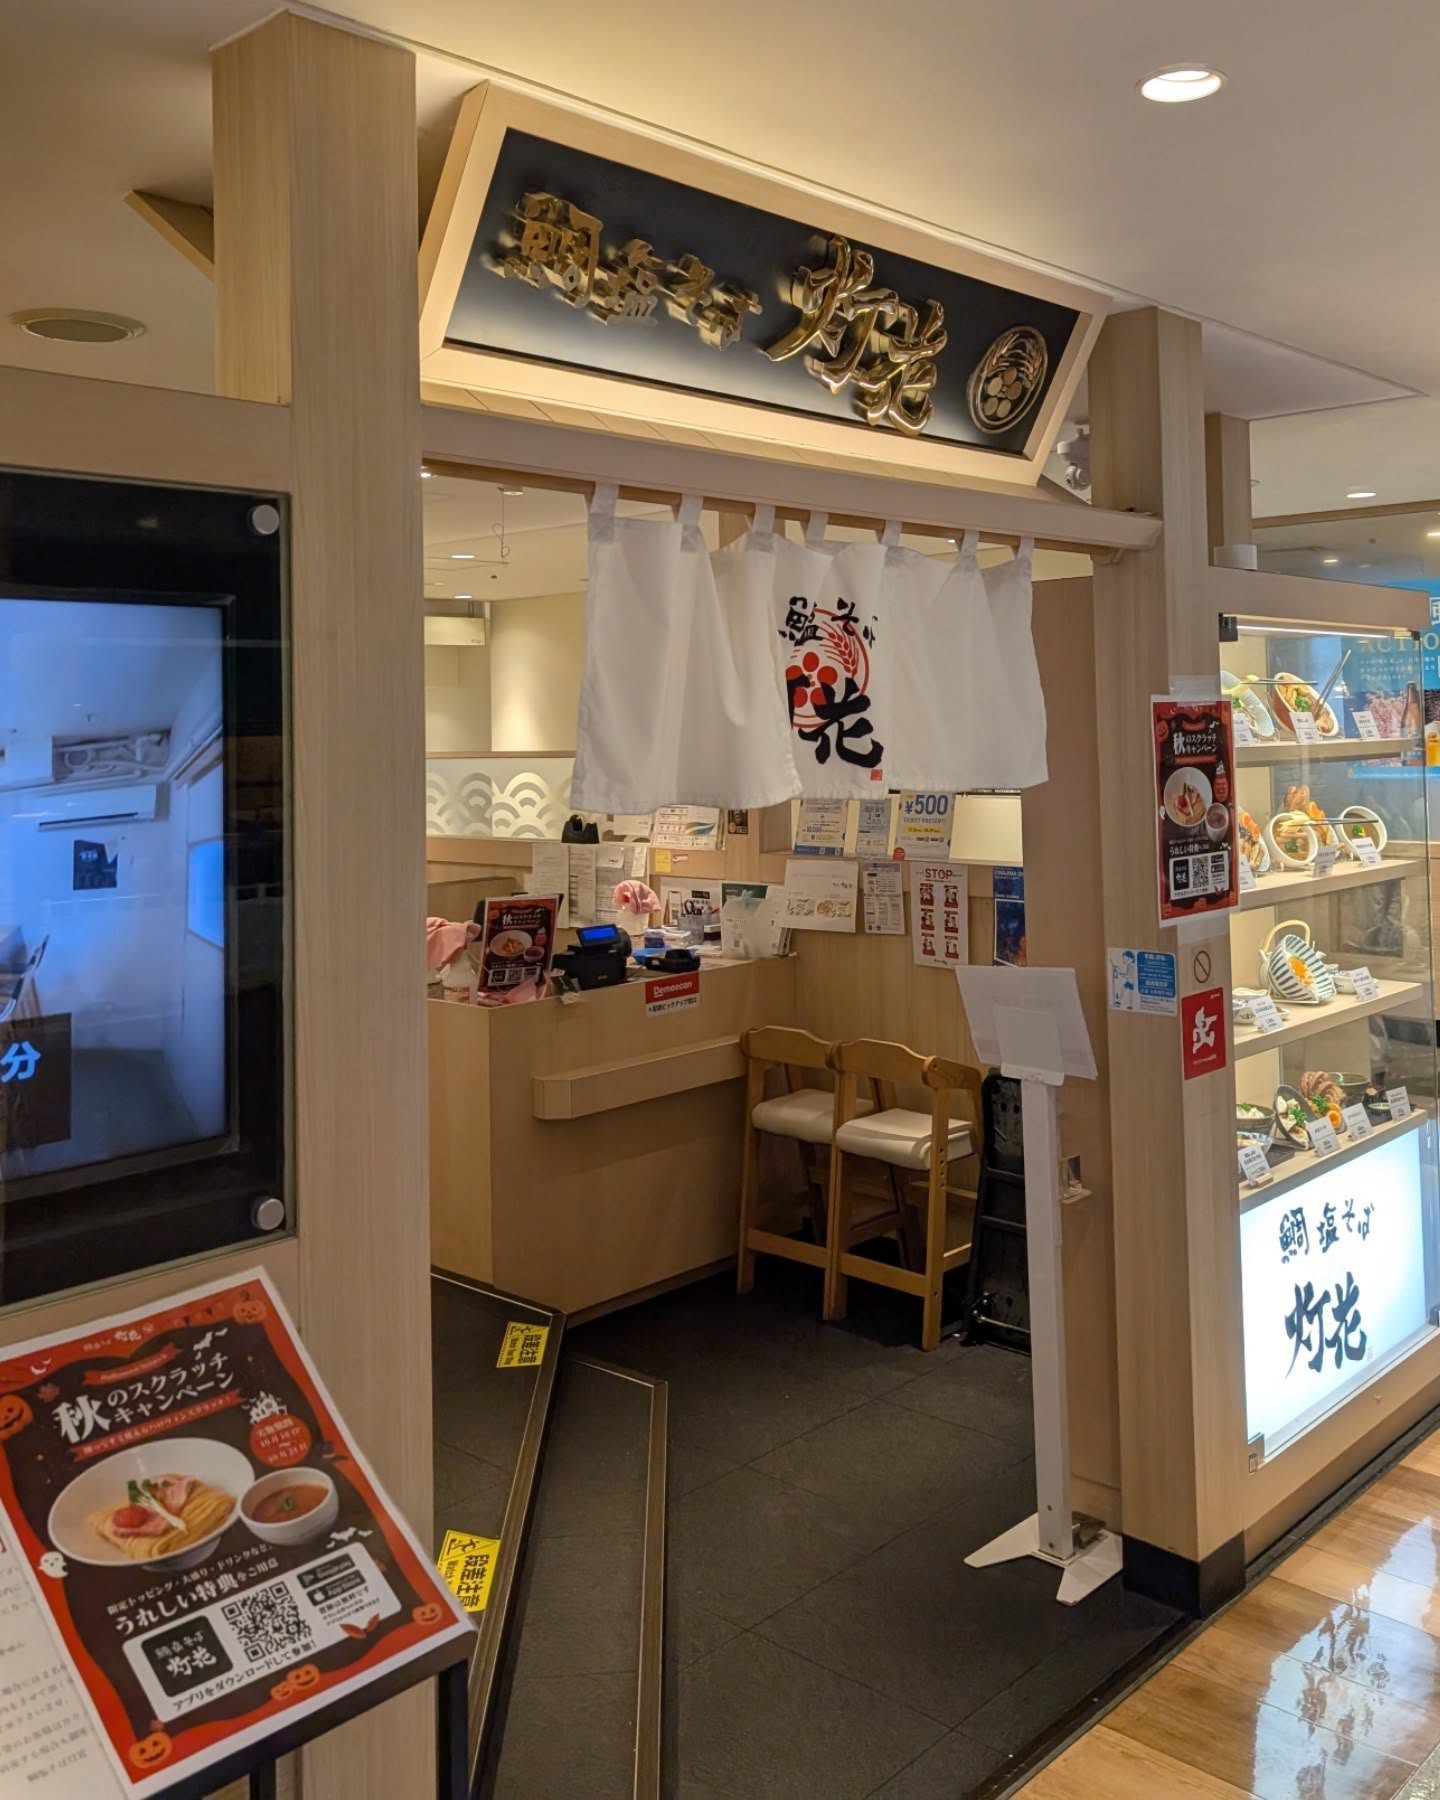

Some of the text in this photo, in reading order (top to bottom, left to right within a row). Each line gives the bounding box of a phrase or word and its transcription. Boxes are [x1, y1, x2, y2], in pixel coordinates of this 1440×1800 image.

[786, 673, 884, 769] 花
[905, 794, 949, 815] ¥500
[925, 868, 953, 880] STOP
[0, 1041, 41, 1083] 分
[1279, 1198, 1376, 1265] 鯛塩そば
[1285, 1271, 1367, 1380] 灯花
[518, 1333, 542, 1365] 段差注意
[114, 1371, 234, 1425] キャンペーン
[166, 1646, 217, 1678] 灯花
